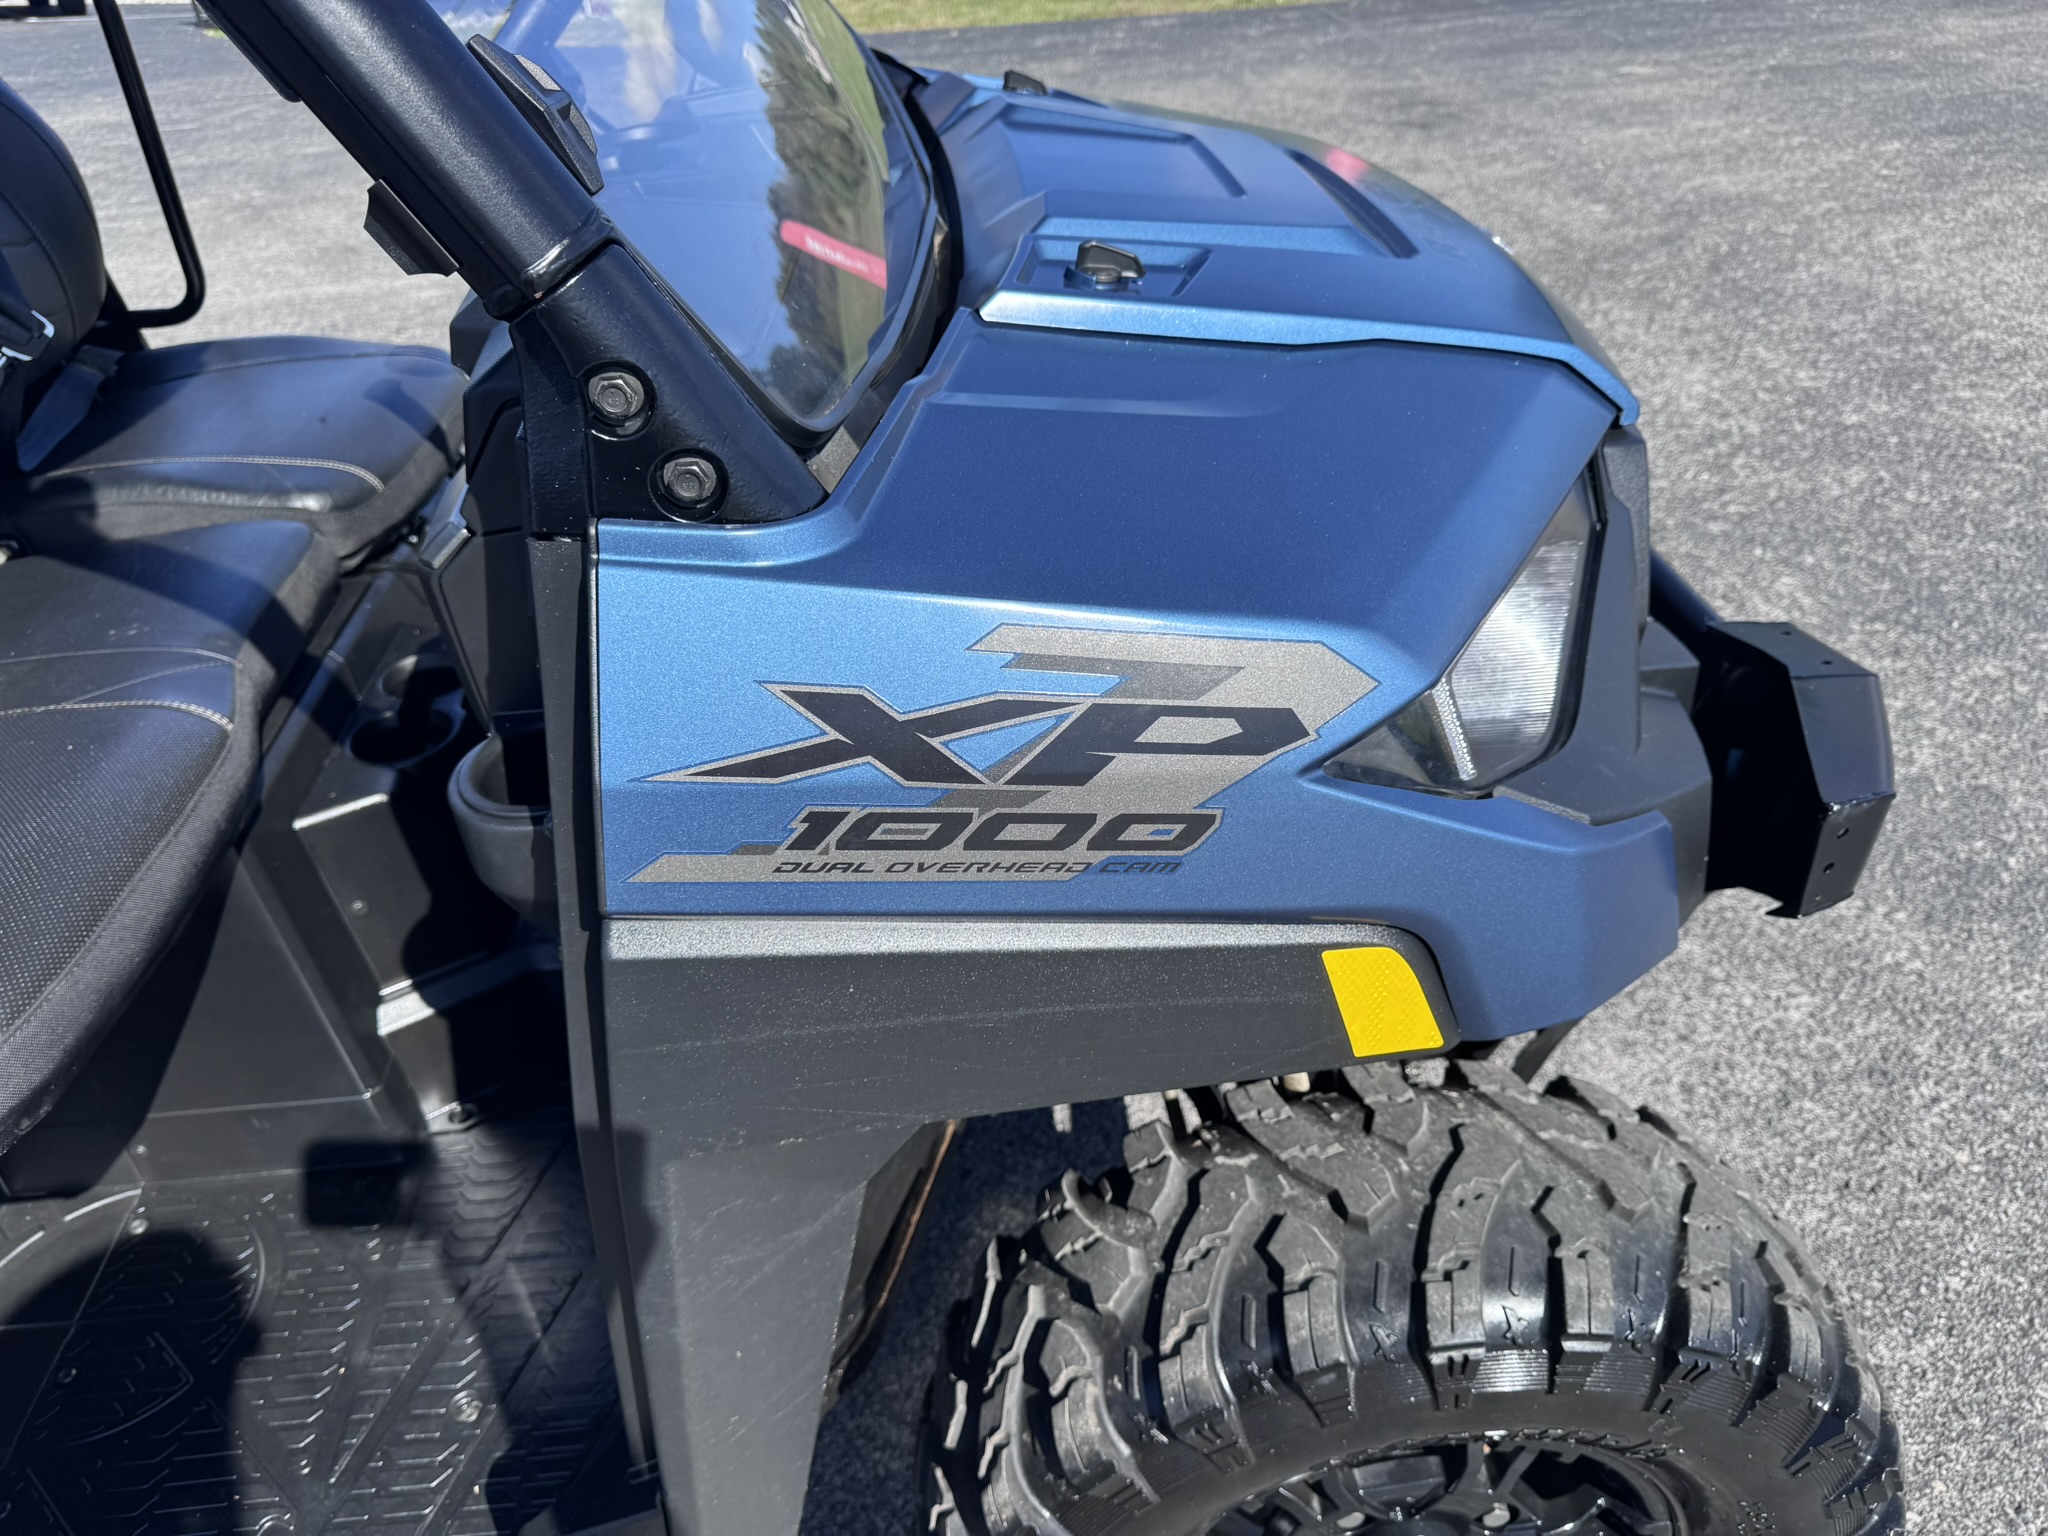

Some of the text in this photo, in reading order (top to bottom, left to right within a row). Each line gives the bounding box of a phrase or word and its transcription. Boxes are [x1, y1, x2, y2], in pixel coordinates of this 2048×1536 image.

[680, 688, 1313, 787] XP
[785, 811, 1217, 851] 1000
[772, 861, 1182, 874] DUAL OVERHEAD CAM
